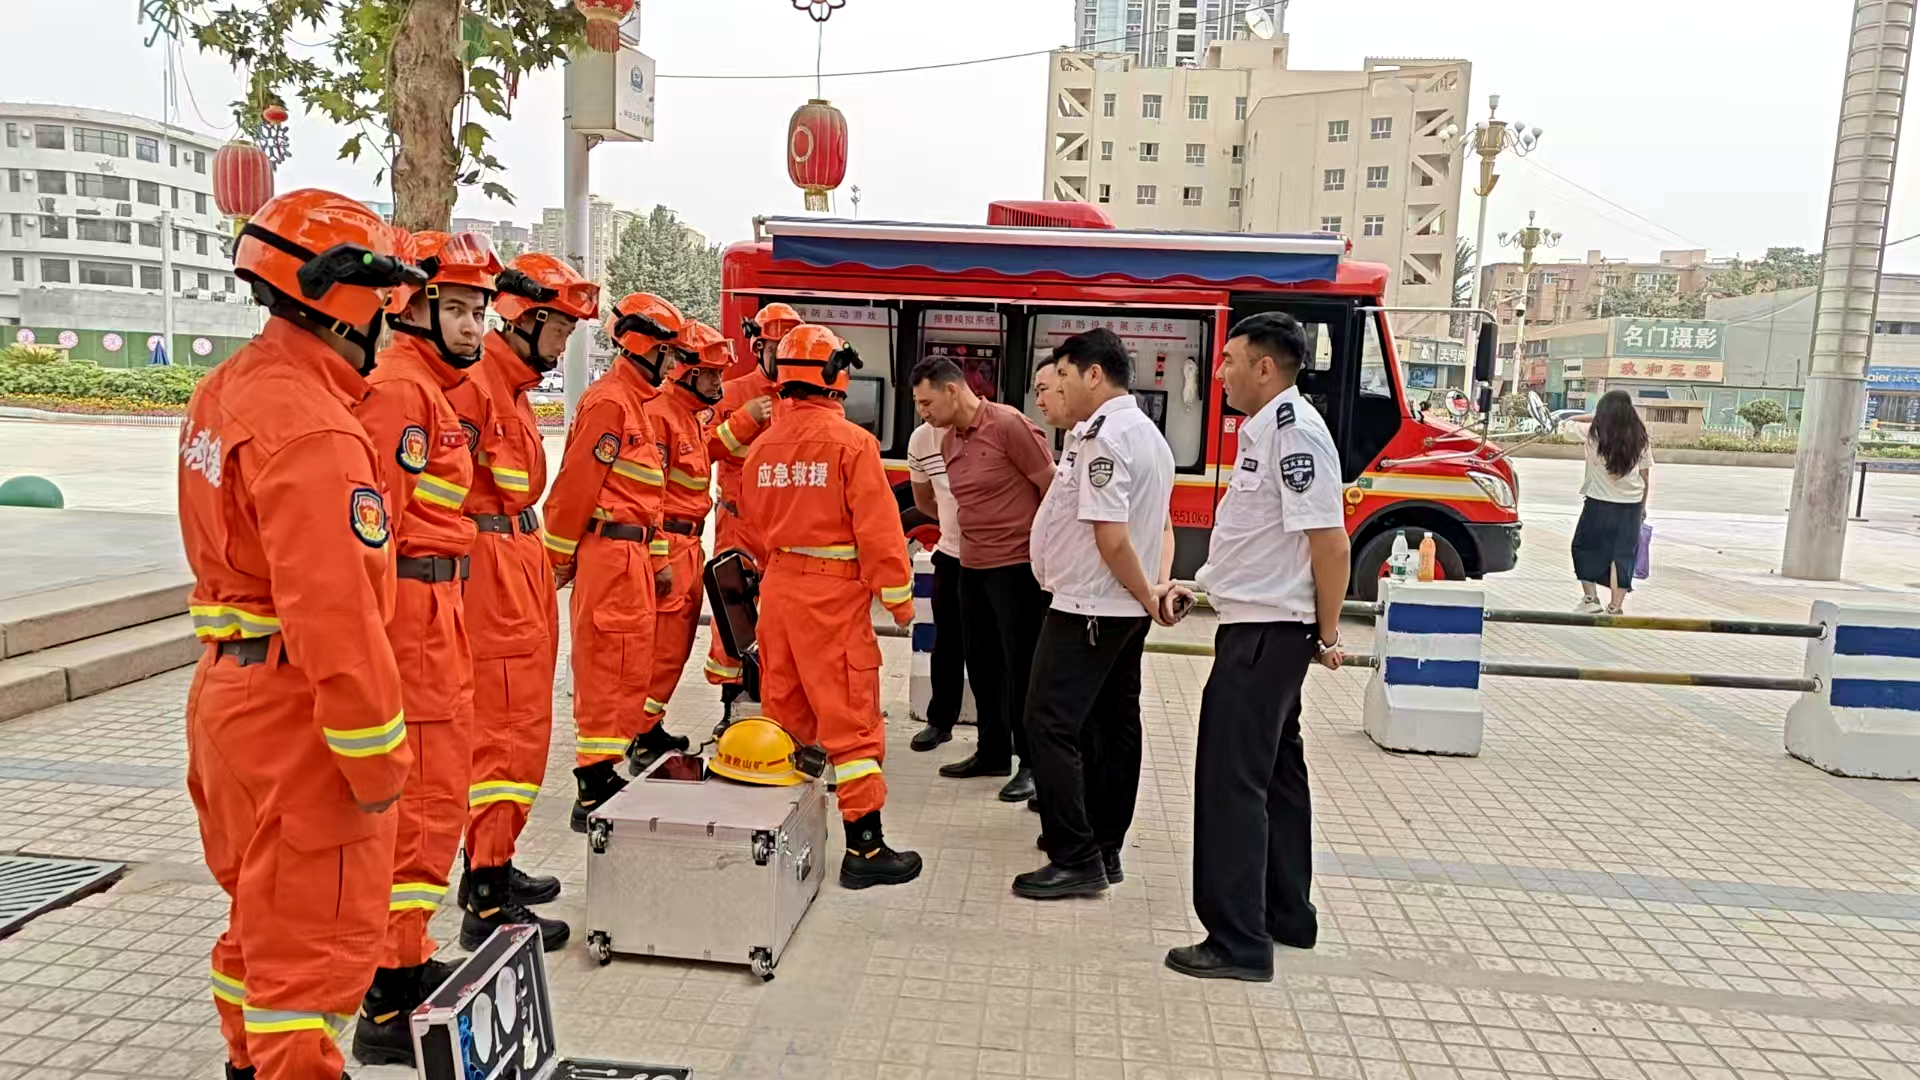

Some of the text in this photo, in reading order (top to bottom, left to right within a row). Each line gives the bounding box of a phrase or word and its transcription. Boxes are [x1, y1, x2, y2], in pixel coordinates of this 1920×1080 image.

[934, 313, 996, 326] 报警模拟系统
[1061, 319, 1174, 332] 消防设备展示系统
[1623, 325, 1718, 349] 名门摄影
[1867, 372, 1889, 383] aier
[757, 461, 829, 488] 应急救援
